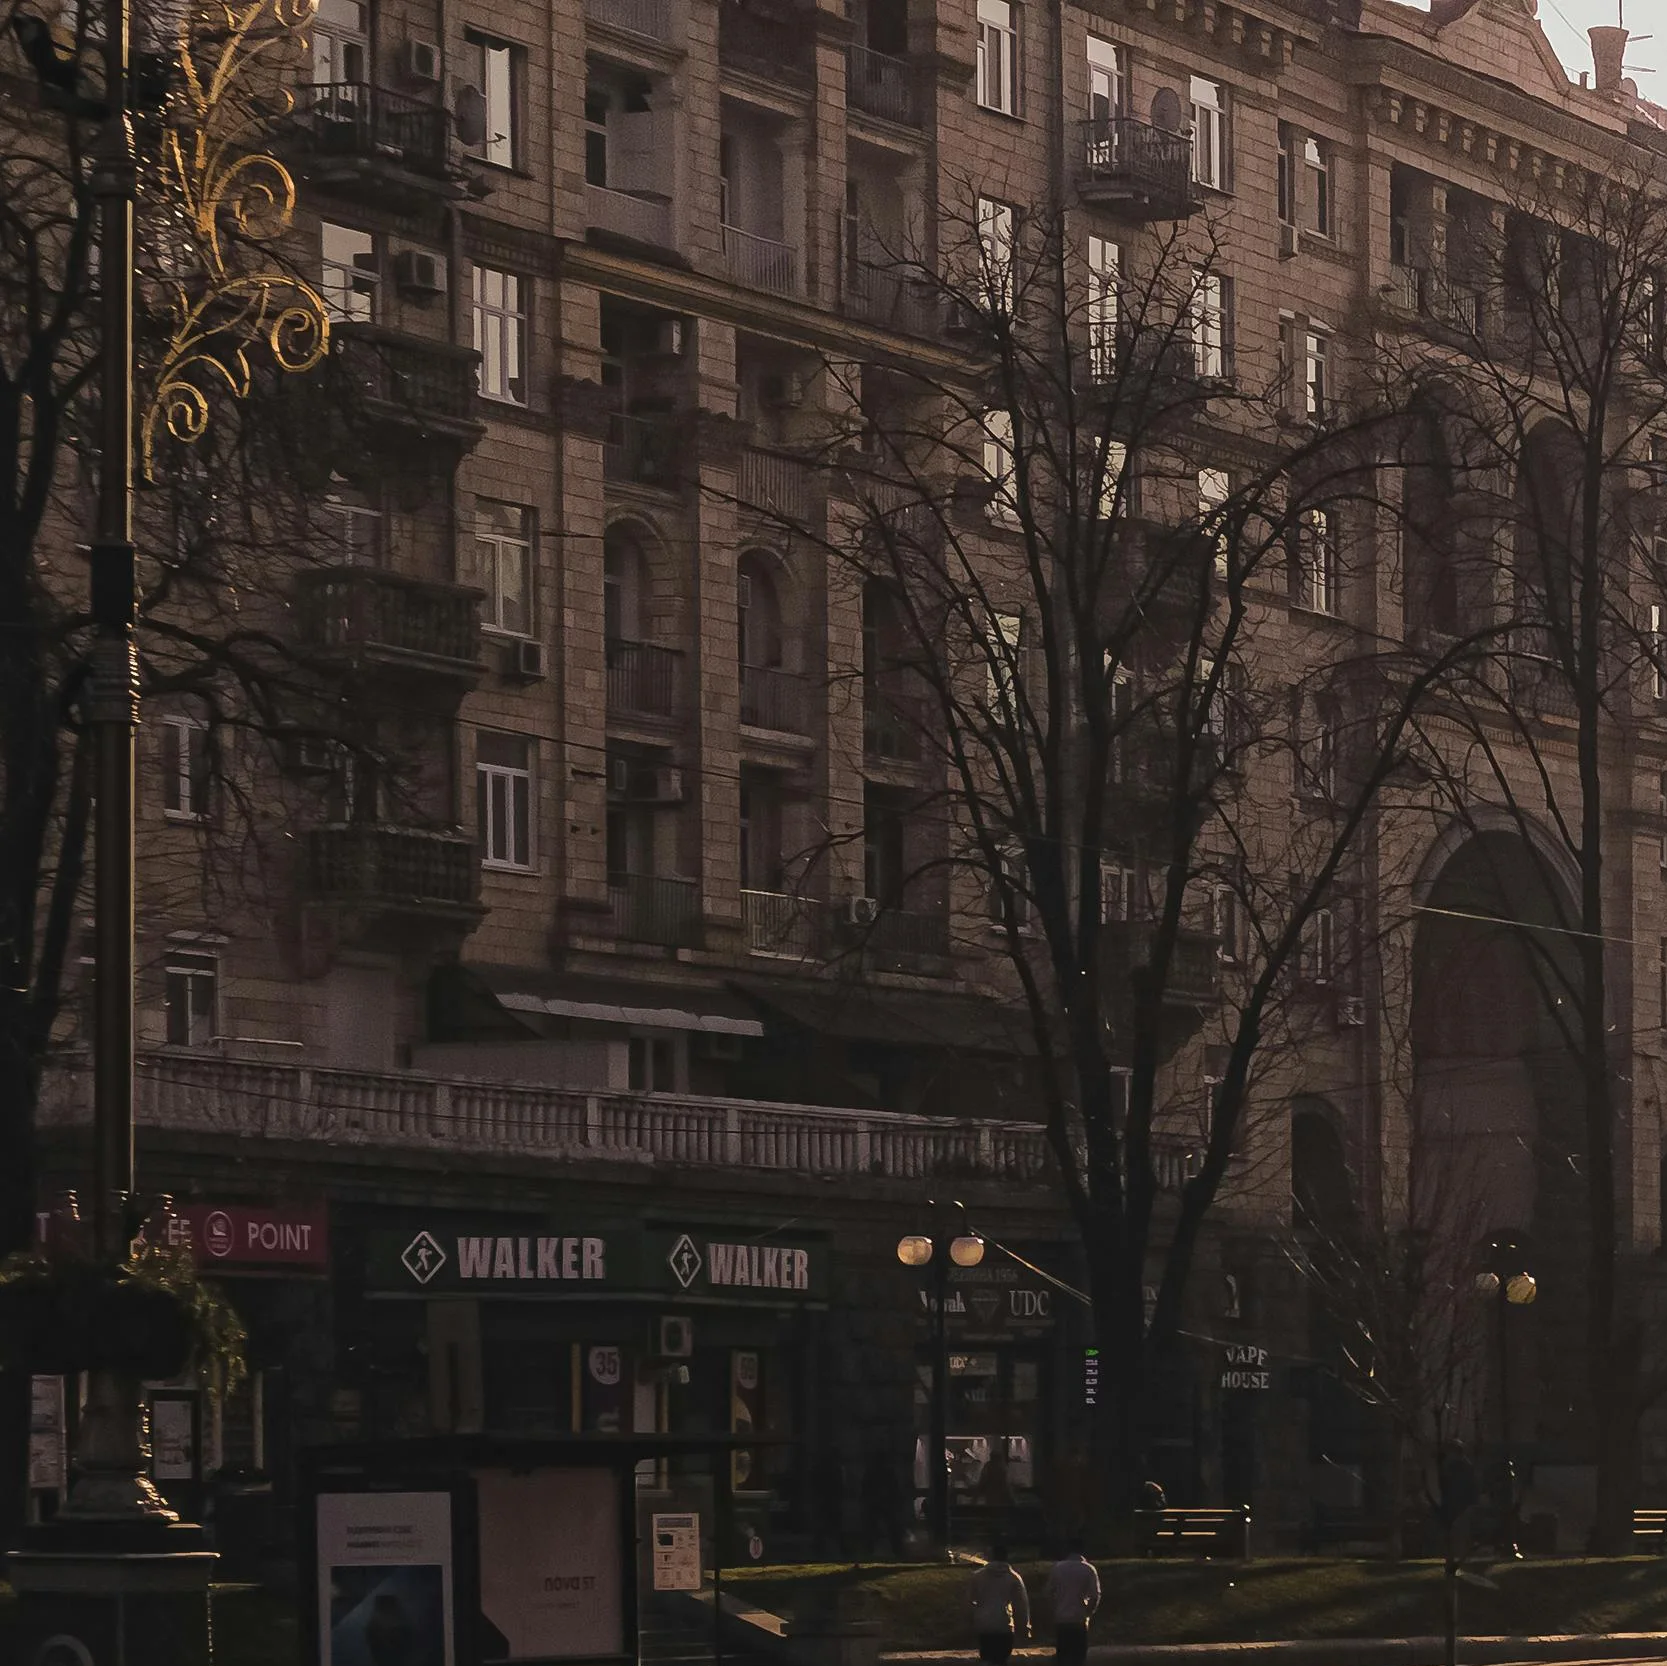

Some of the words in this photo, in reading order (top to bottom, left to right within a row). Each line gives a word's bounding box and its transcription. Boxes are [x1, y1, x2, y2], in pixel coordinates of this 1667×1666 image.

[247, 1221, 312, 1251] POINT
[457, 1237, 605, 1279] WALKER
[707, 1243, 809, 1290] WALKER
[1009, 1290, 1049, 1316] UDC
[1221, 1372, 1269, 1389] HOUSE
